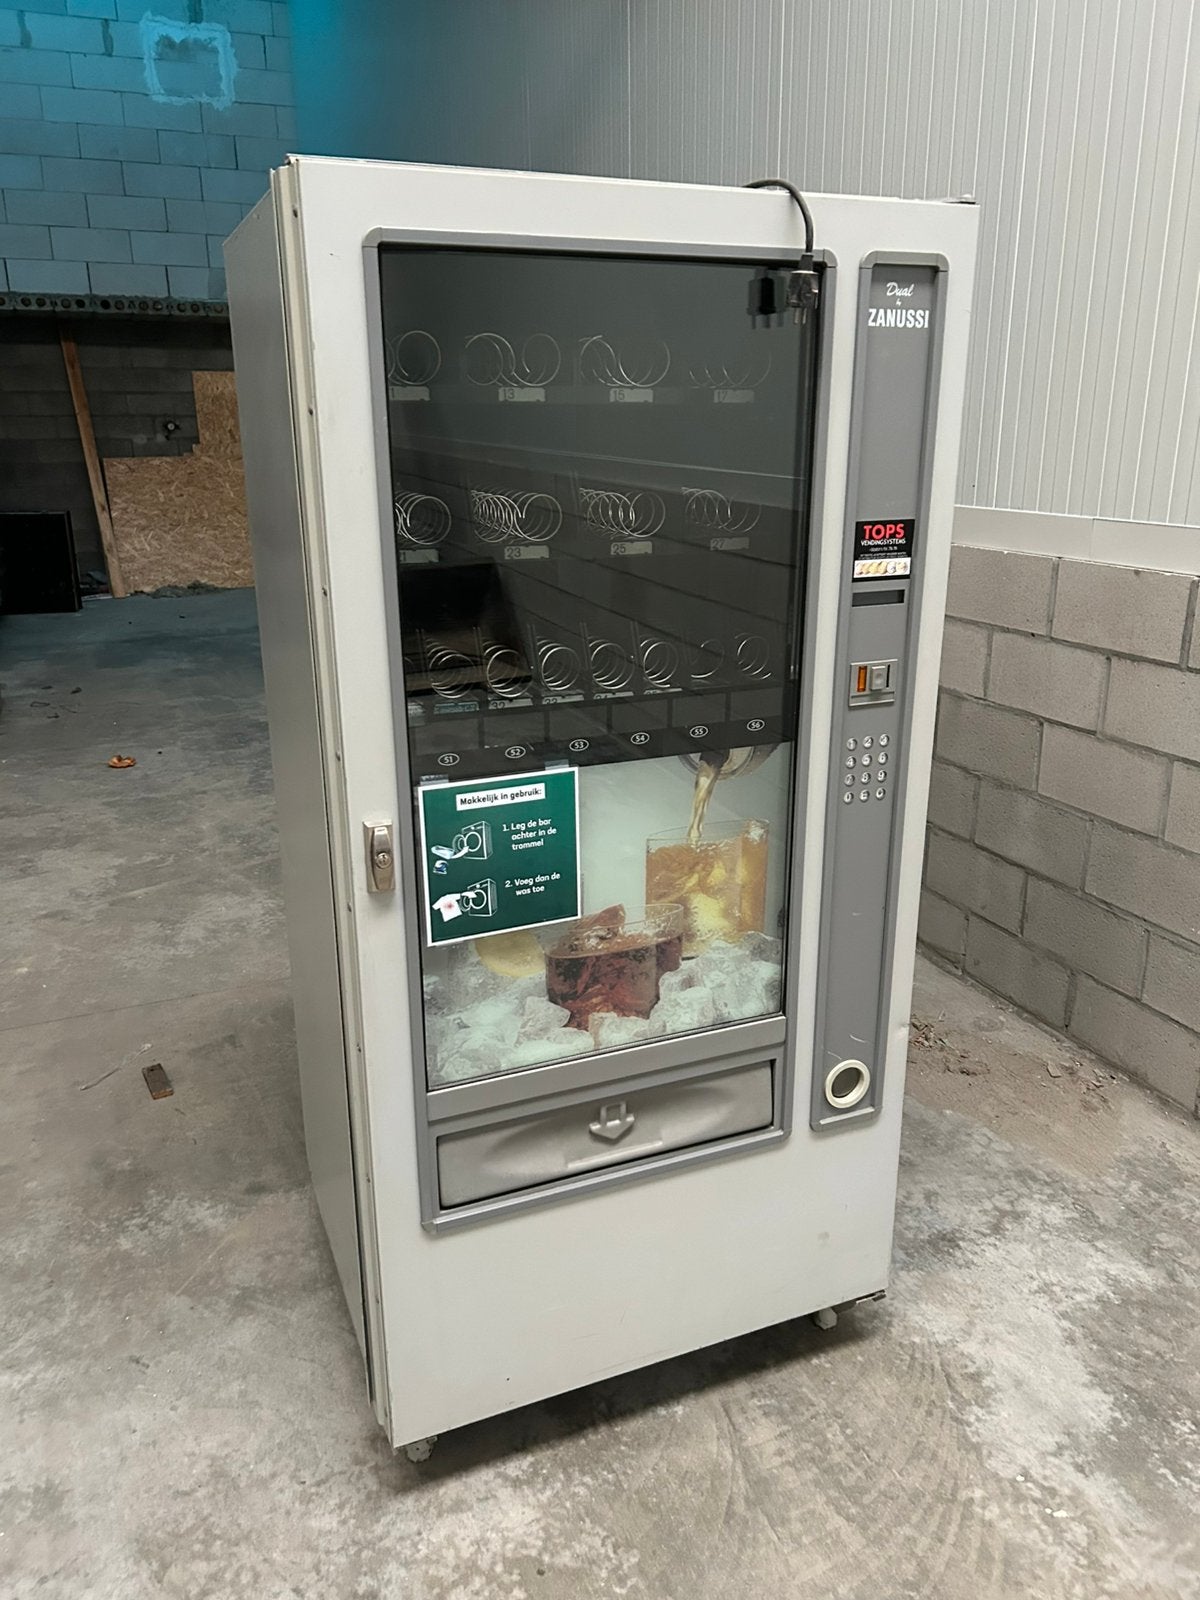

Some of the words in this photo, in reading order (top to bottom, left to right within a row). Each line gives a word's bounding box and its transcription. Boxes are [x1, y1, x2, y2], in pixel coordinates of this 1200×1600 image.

[886, 281, 914, 297] Dual
[868, 308, 930, 329] ZANUSSI
[503, 388, 516, 400] 13
[613, 389, 625, 401] 15
[863, 523, 905, 540] TOPS
[612, 544, 626, 554] 25
[712, 539, 725, 549] 27
[506, 548, 521, 558] 23
[460, 793, 499, 805] Makkelijk
[510, 788, 542, 800] gebruik:
[502, 824, 510, 832] 1.
[511, 822, 526, 831] Leg
[527, 820, 537, 828] de
[511, 831, 537, 841] achter
[547, 826, 557, 835] de
[511, 838, 544, 850] trommel
[504, 880, 513, 888] 2.
[514, 877, 534, 886] Voeg
[535, 874, 550, 883] dan
[551, 872, 561, 880] de
[515, 888, 531, 896] was
[532, 885, 545, 893] toe
